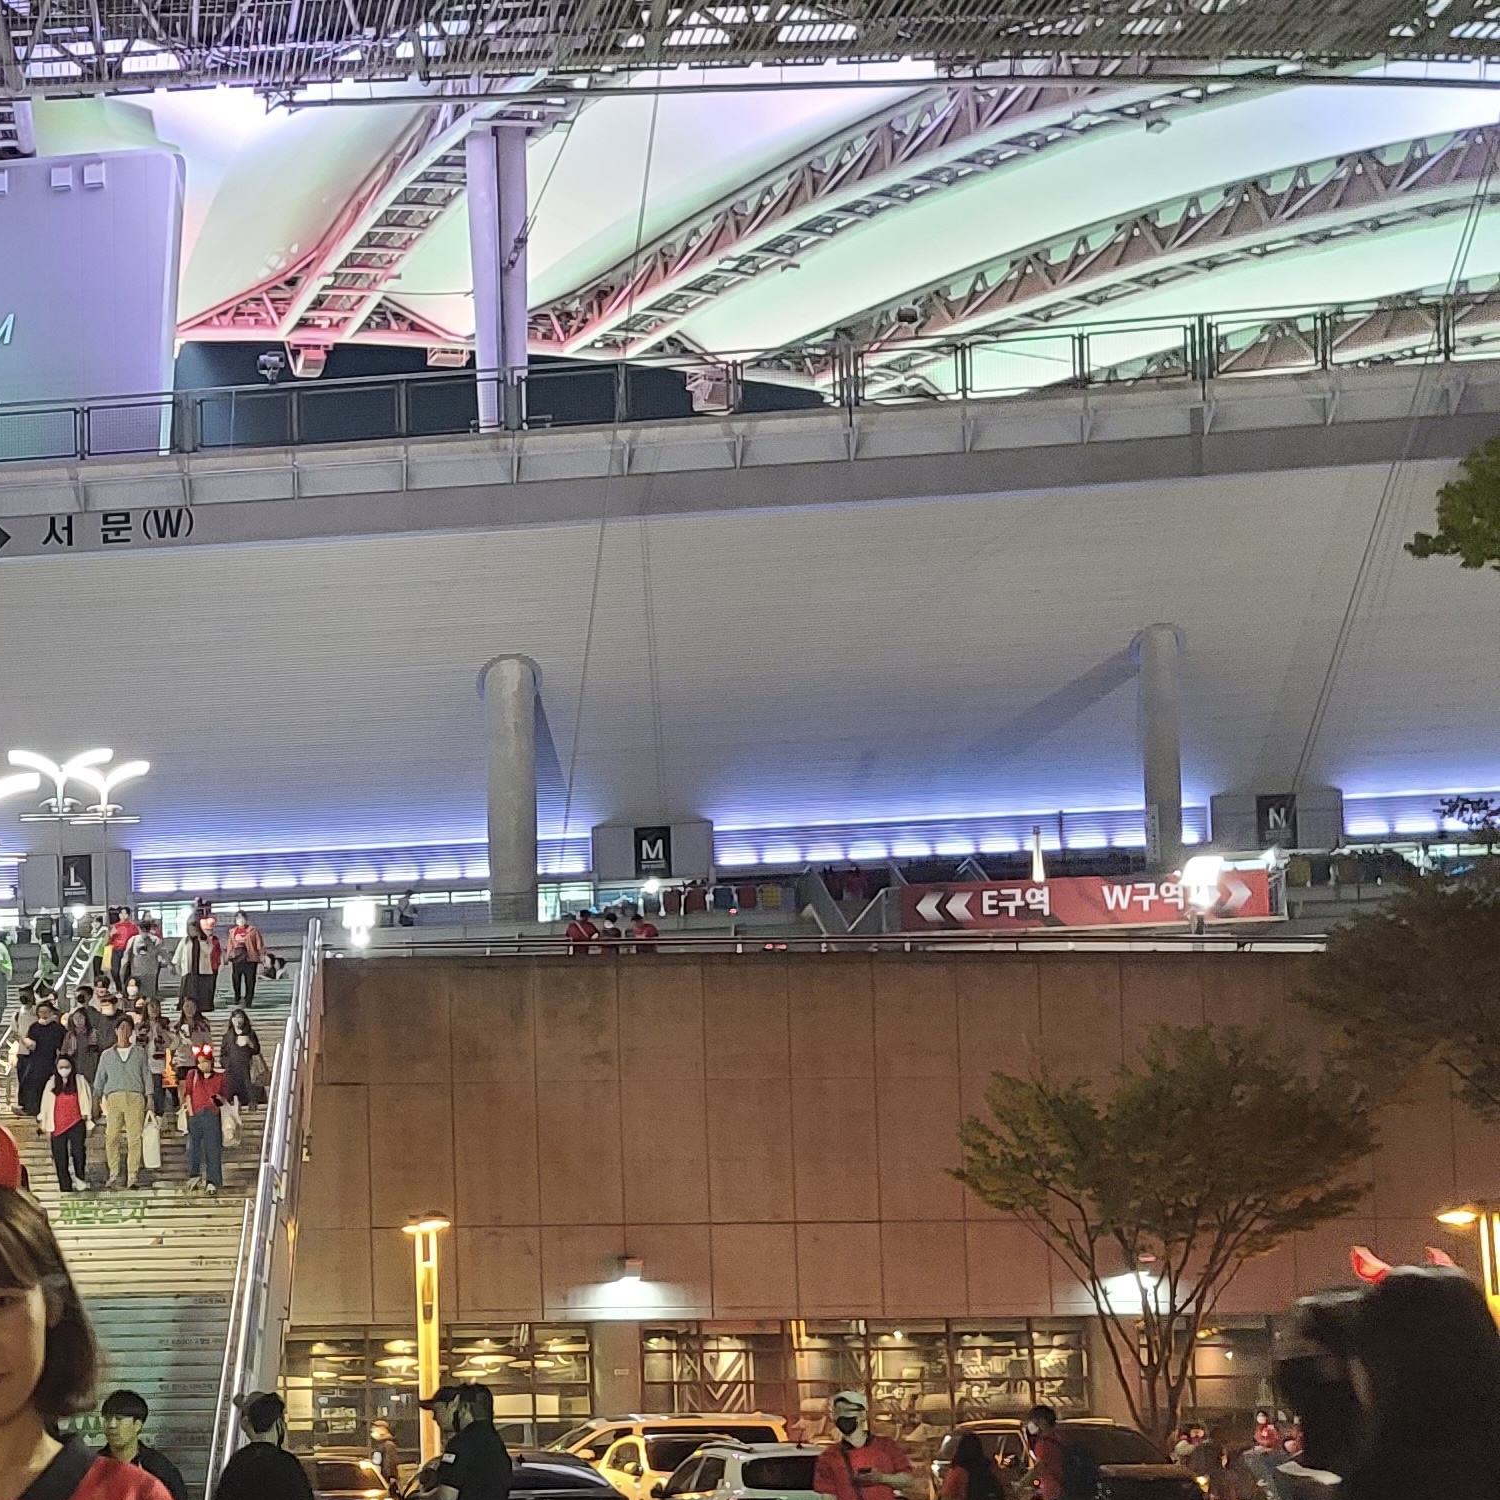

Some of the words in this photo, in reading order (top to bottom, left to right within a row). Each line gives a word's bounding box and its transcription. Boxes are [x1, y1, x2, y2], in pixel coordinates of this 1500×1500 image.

[1268, 807, 1286, 830] N
[641, 838, 664, 860] M
[69, 866, 81, 887] L
[981, 885, 1051, 917] E구역
[1101, 881, 1185, 913] W구역
